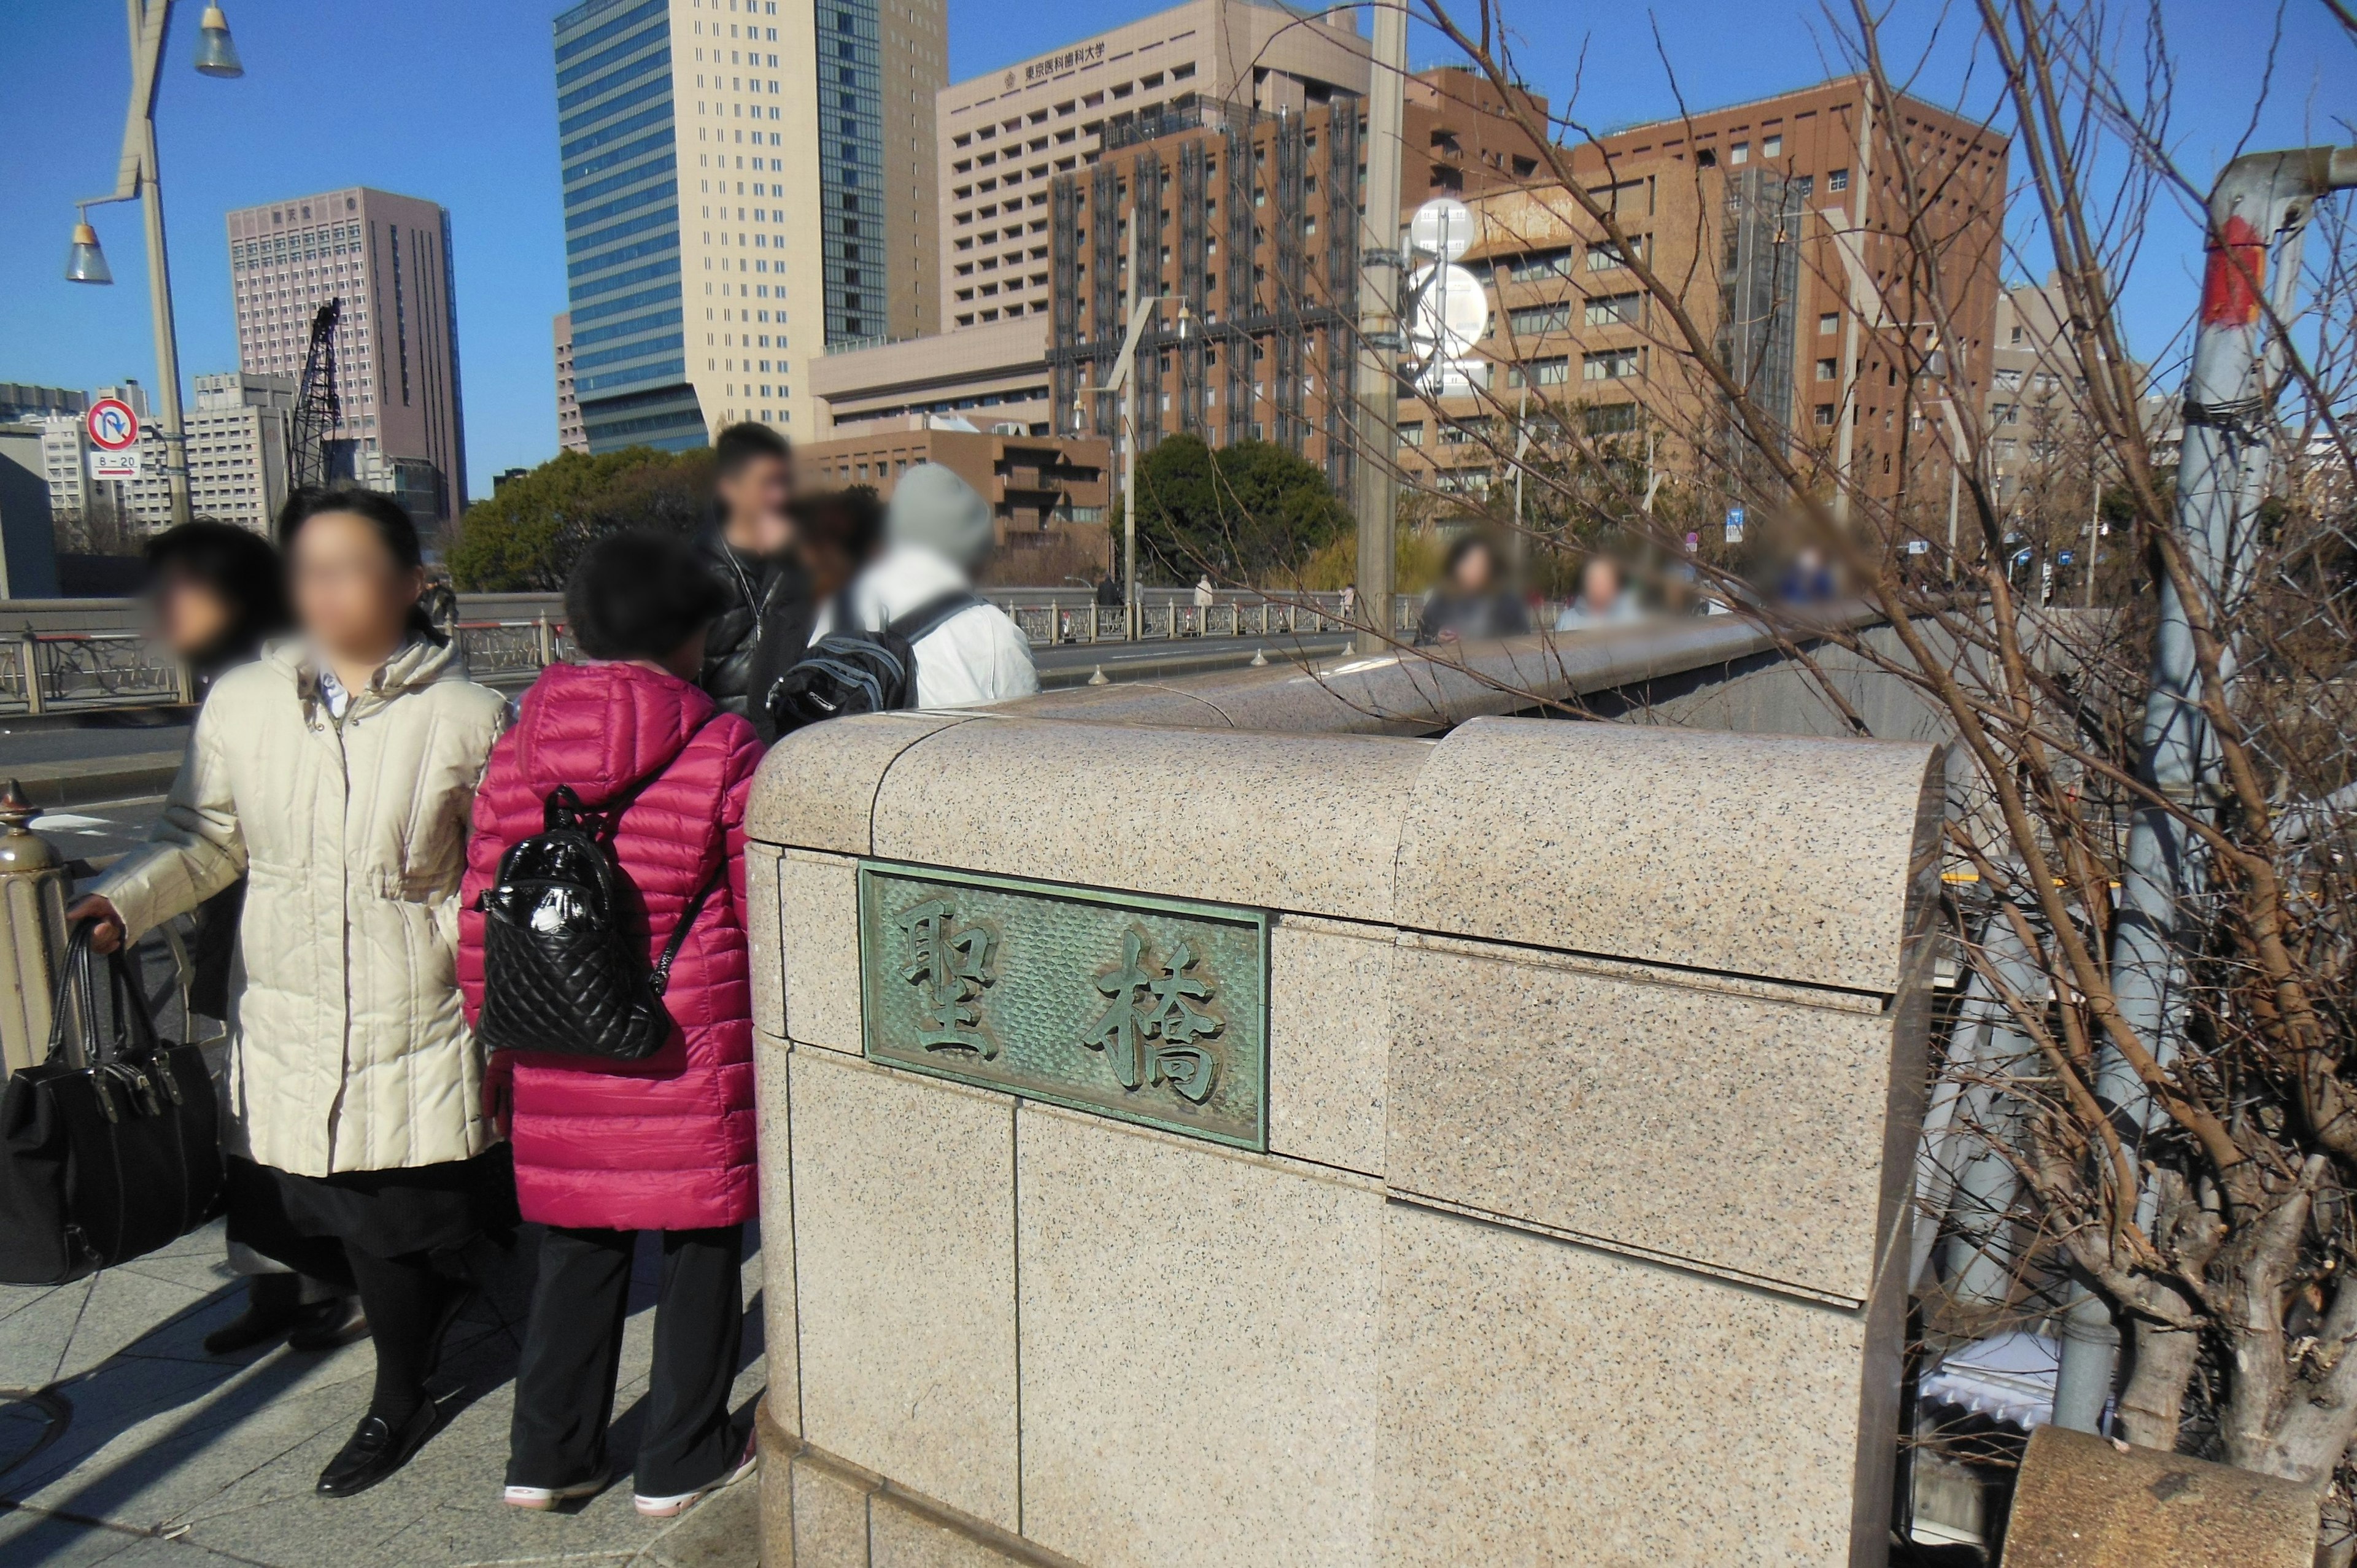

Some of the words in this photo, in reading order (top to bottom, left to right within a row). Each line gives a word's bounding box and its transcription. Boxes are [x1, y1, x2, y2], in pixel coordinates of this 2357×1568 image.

[1026, 41, 1104, 81] 東京医科歯科大学
[892, 898, 1223, 1105] 聖橋
